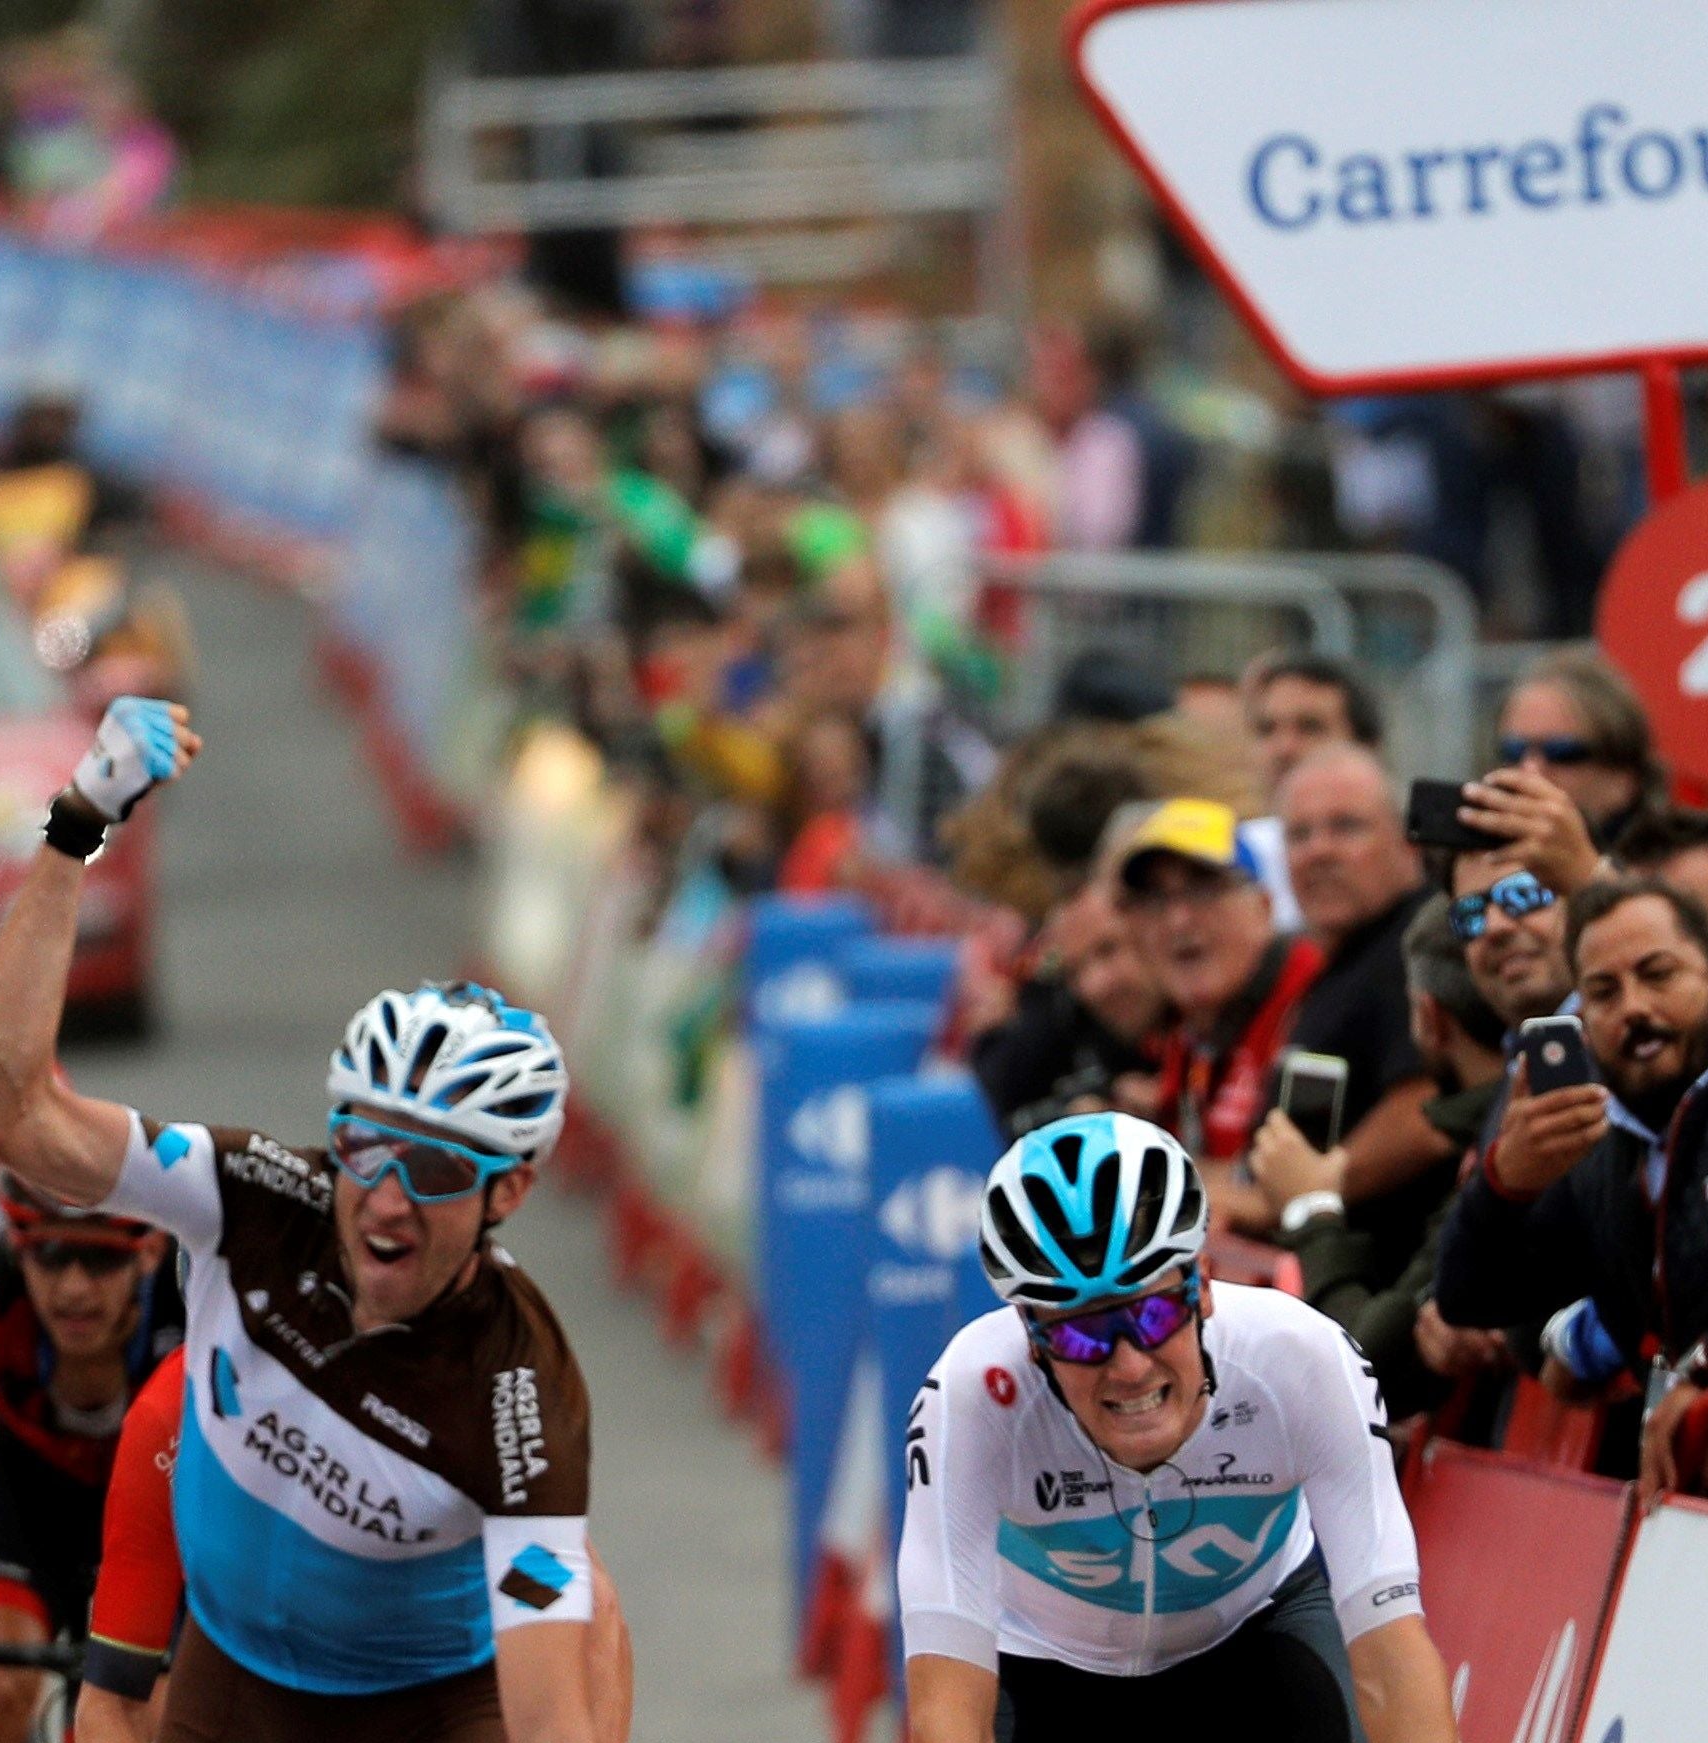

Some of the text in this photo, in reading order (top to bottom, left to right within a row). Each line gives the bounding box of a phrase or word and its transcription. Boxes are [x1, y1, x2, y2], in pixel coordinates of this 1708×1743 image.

[245, 1429, 439, 1544] MONDIALE
[257, 1411, 350, 1489] AG2R
[358, 1480, 404, 1521] LA
